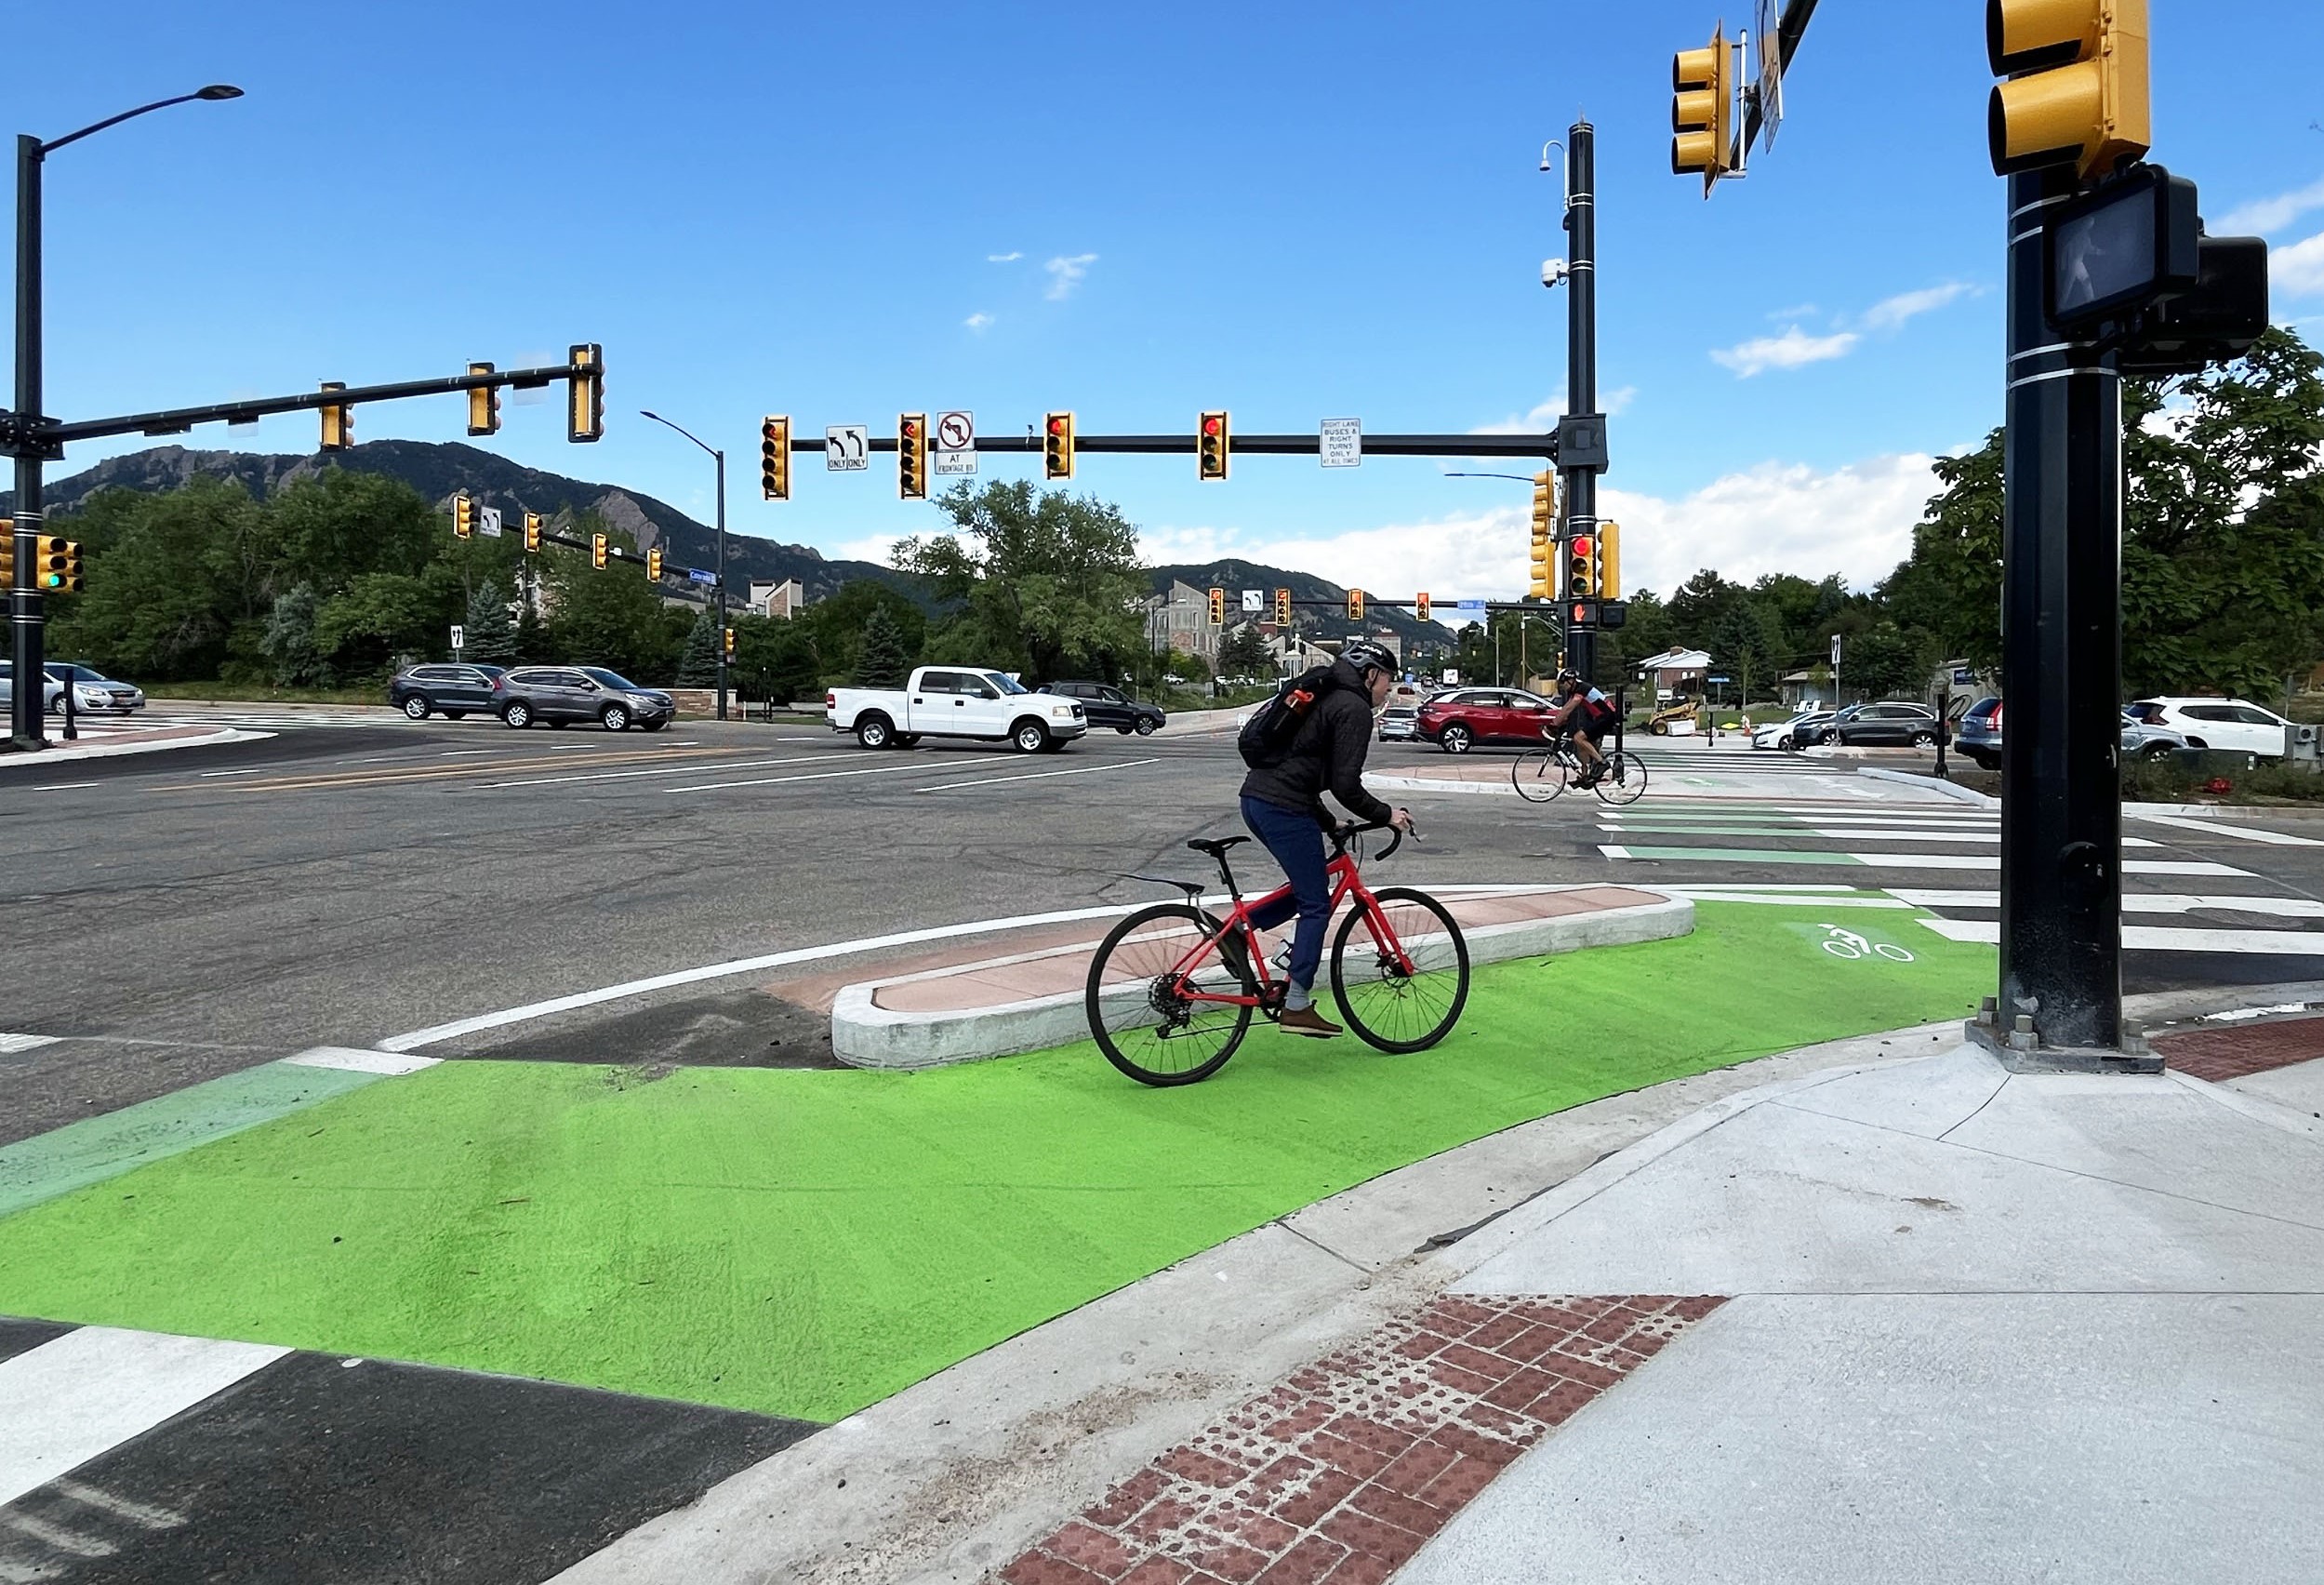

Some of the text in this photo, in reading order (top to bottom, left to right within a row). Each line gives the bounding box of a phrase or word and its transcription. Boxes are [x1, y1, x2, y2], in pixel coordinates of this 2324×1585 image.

[950, 454, 960, 463] AT
[829, 459, 865, 468] ONLY ONLY
